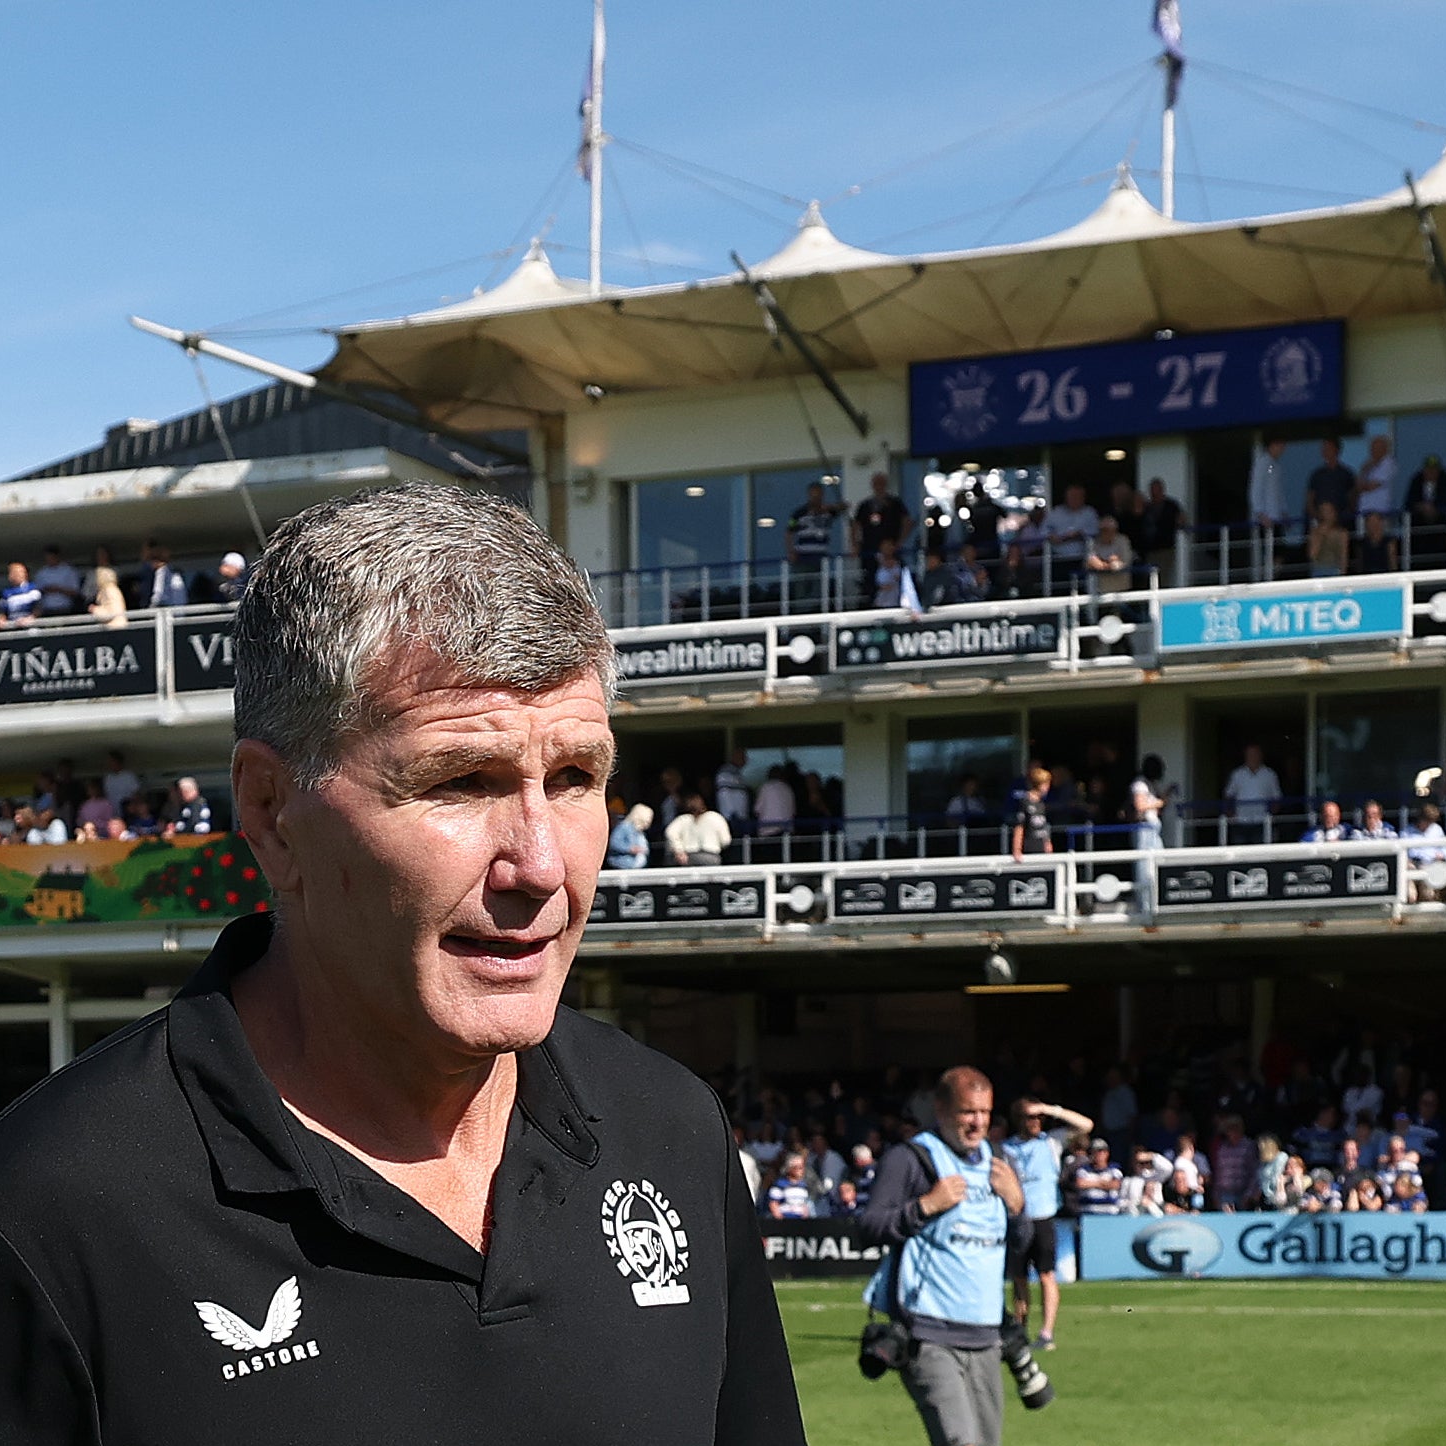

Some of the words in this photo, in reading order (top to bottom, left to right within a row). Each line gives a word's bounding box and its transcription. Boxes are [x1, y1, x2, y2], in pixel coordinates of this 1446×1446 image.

[1016, 366, 1089, 424] 26
[1157, 350, 1228, 412] 27
[891, 621, 1055, 658] wealthtime
[601, 1180, 632, 1277] EXETER
[641, 1179, 689, 1269] RUGBY
[222, 1340, 320, 1380] CASTORE
